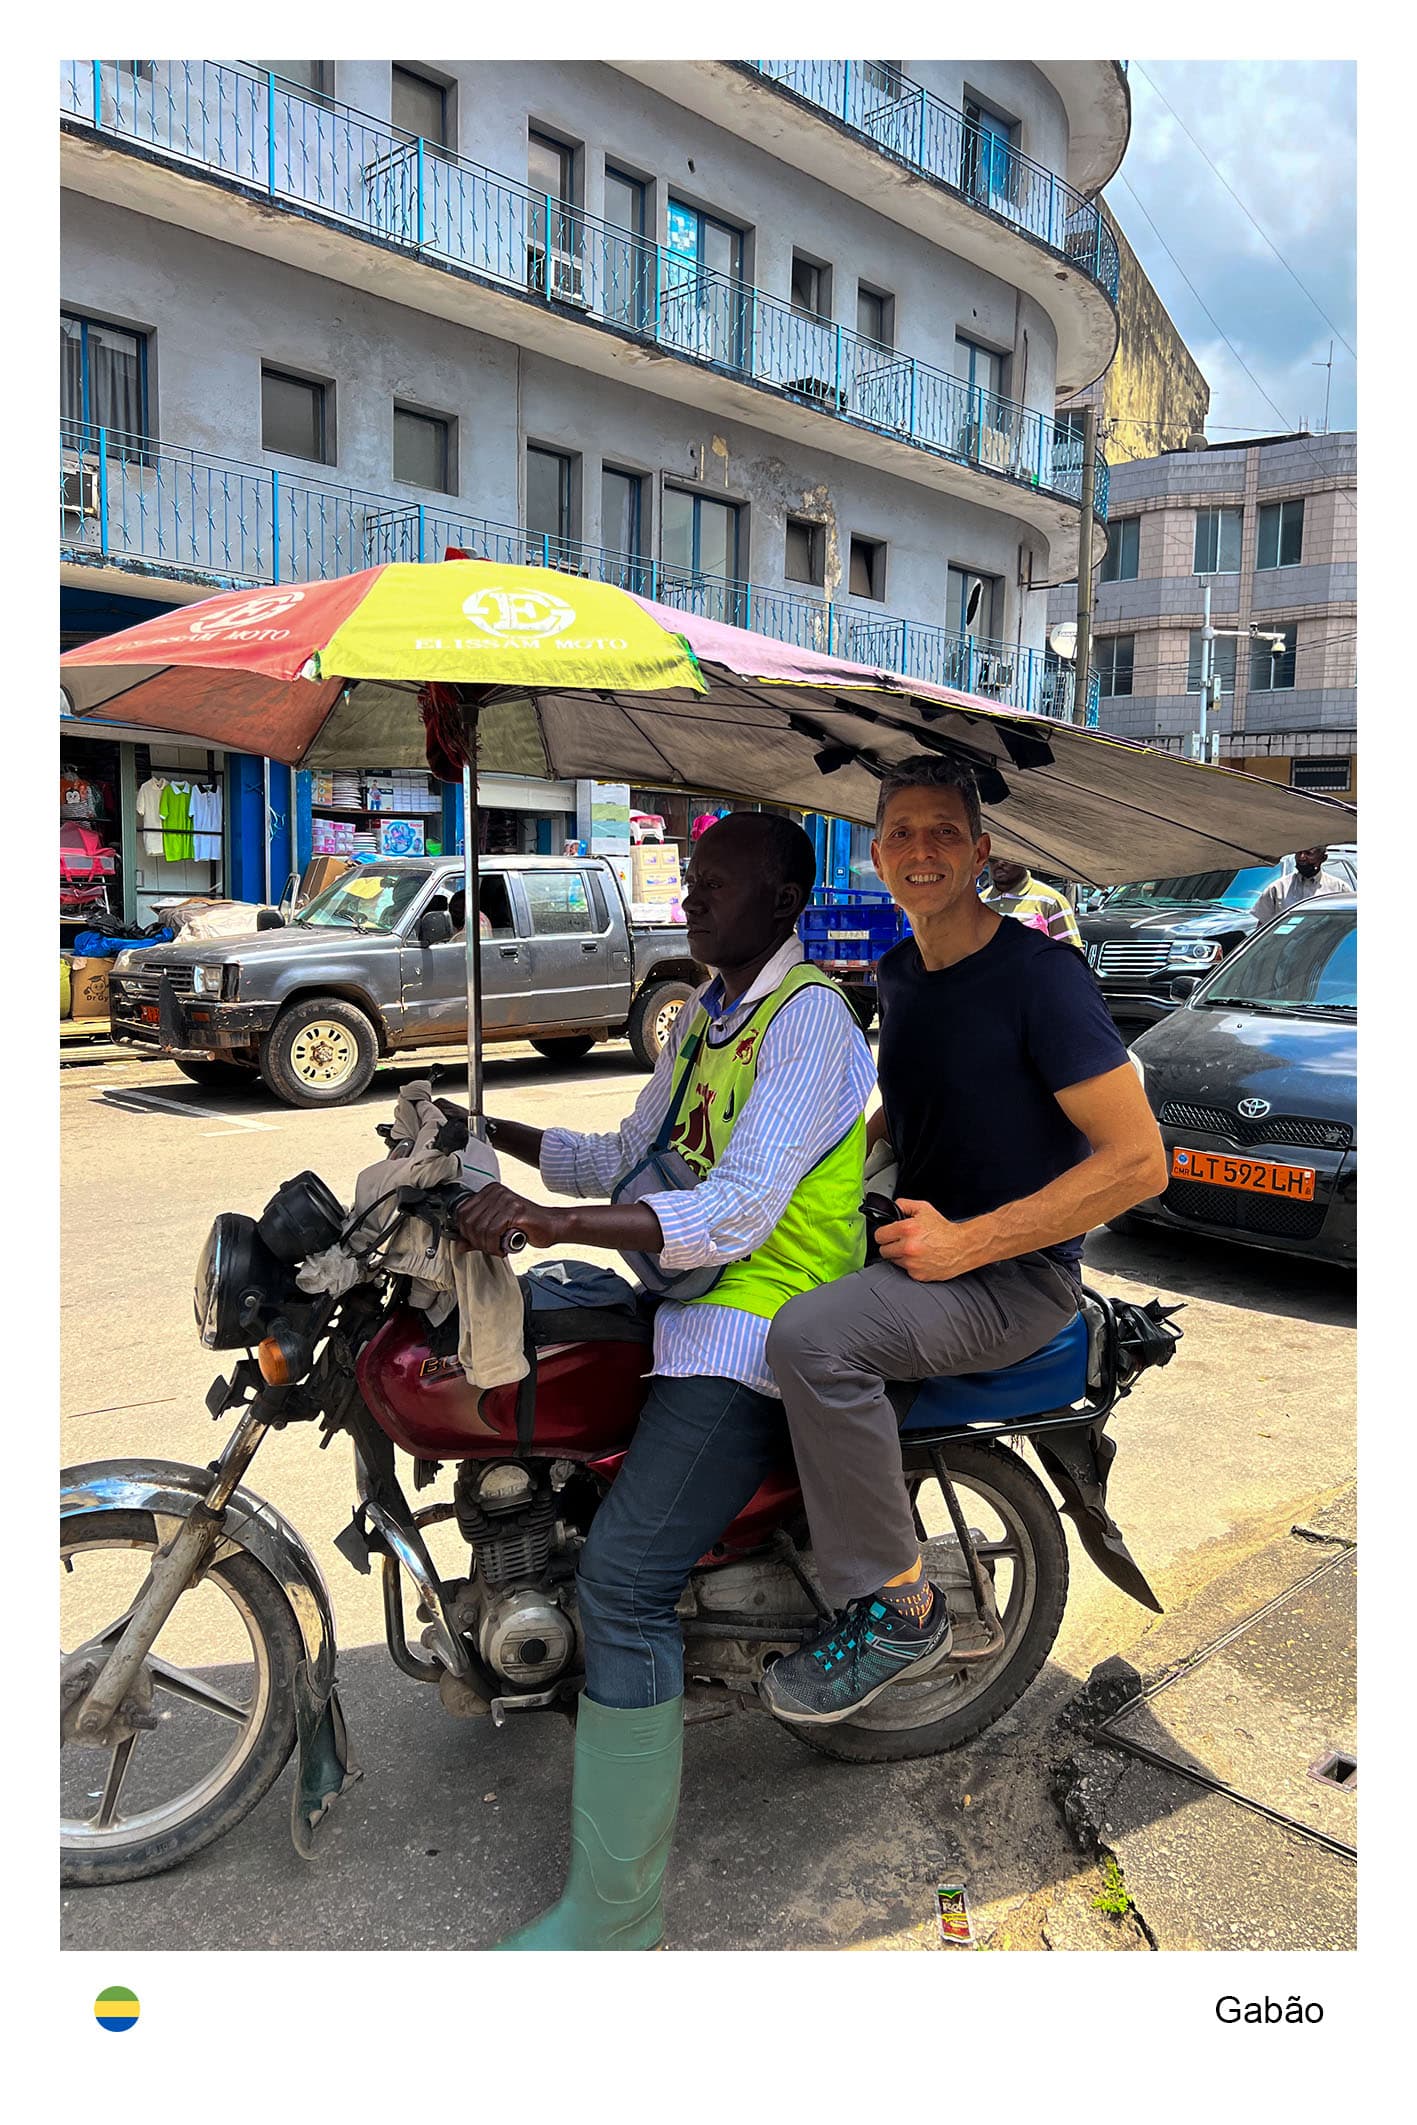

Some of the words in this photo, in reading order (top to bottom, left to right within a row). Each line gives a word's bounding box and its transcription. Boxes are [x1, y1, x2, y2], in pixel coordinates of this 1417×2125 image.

[222, 629, 290, 642] MOTO
[415, 638, 541, 650] ELISSAM
[556, 638, 629, 650] MOTO
[1190, 1154, 1220, 1180] LT
[1223, 1160, 1267, 1188] 592
[1271, 1168, 1304, 1194] LH
